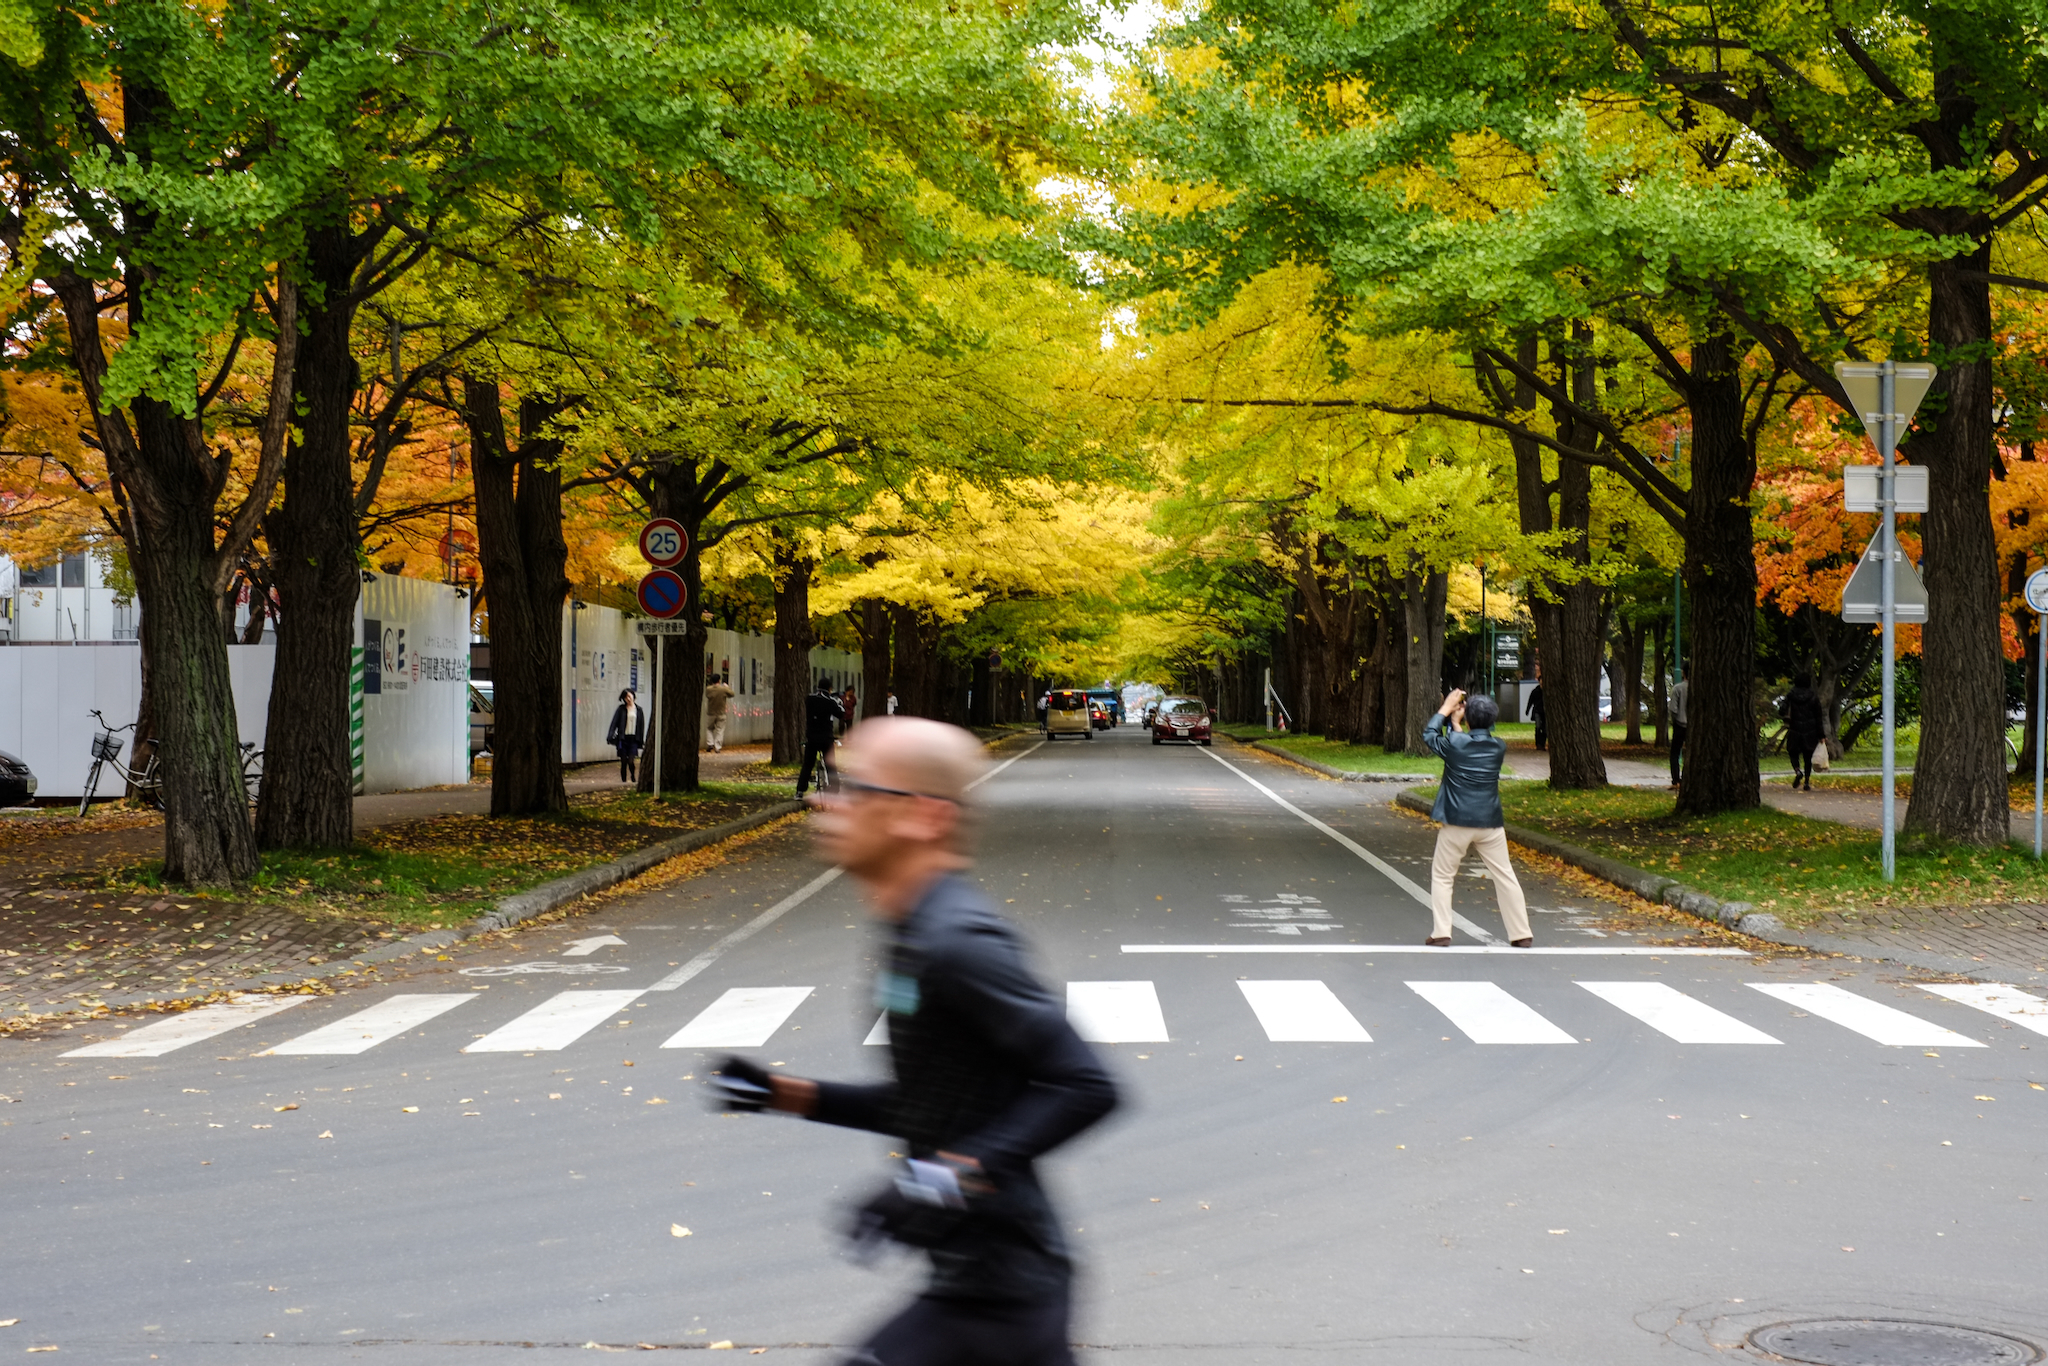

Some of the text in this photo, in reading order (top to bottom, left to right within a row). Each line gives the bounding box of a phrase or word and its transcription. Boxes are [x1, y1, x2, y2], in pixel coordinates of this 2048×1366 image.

[650, 532, 677, 554] 25
[637, 621, 685, 633] 構内歩行者優先
